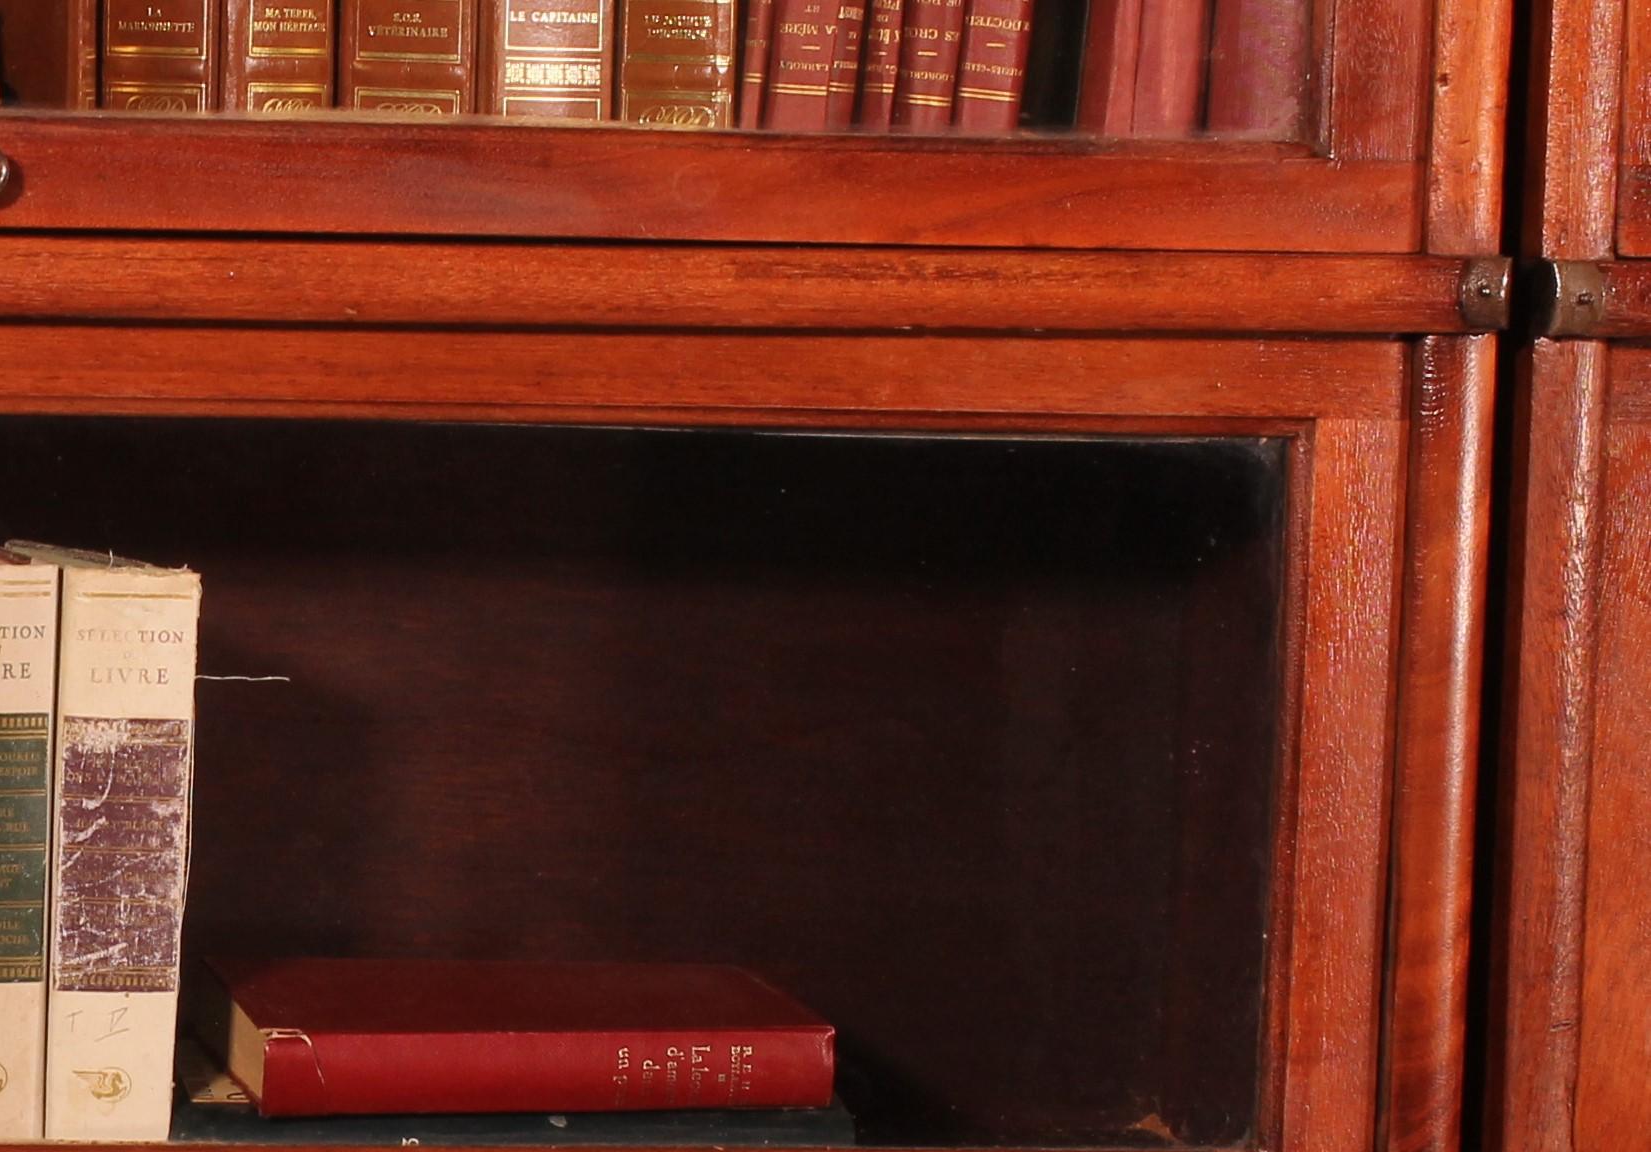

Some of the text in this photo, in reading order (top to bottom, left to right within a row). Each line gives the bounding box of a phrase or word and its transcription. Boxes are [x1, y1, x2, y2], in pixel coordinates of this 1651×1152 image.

[253, 22, 277, 32] MON
[510, 12, 598, 24] LE CAPITAINE
[90, 665, 170, 686] LIVRE
[617, 1047, 631, 1070] un
[691, 1044, 711, 1064] La
